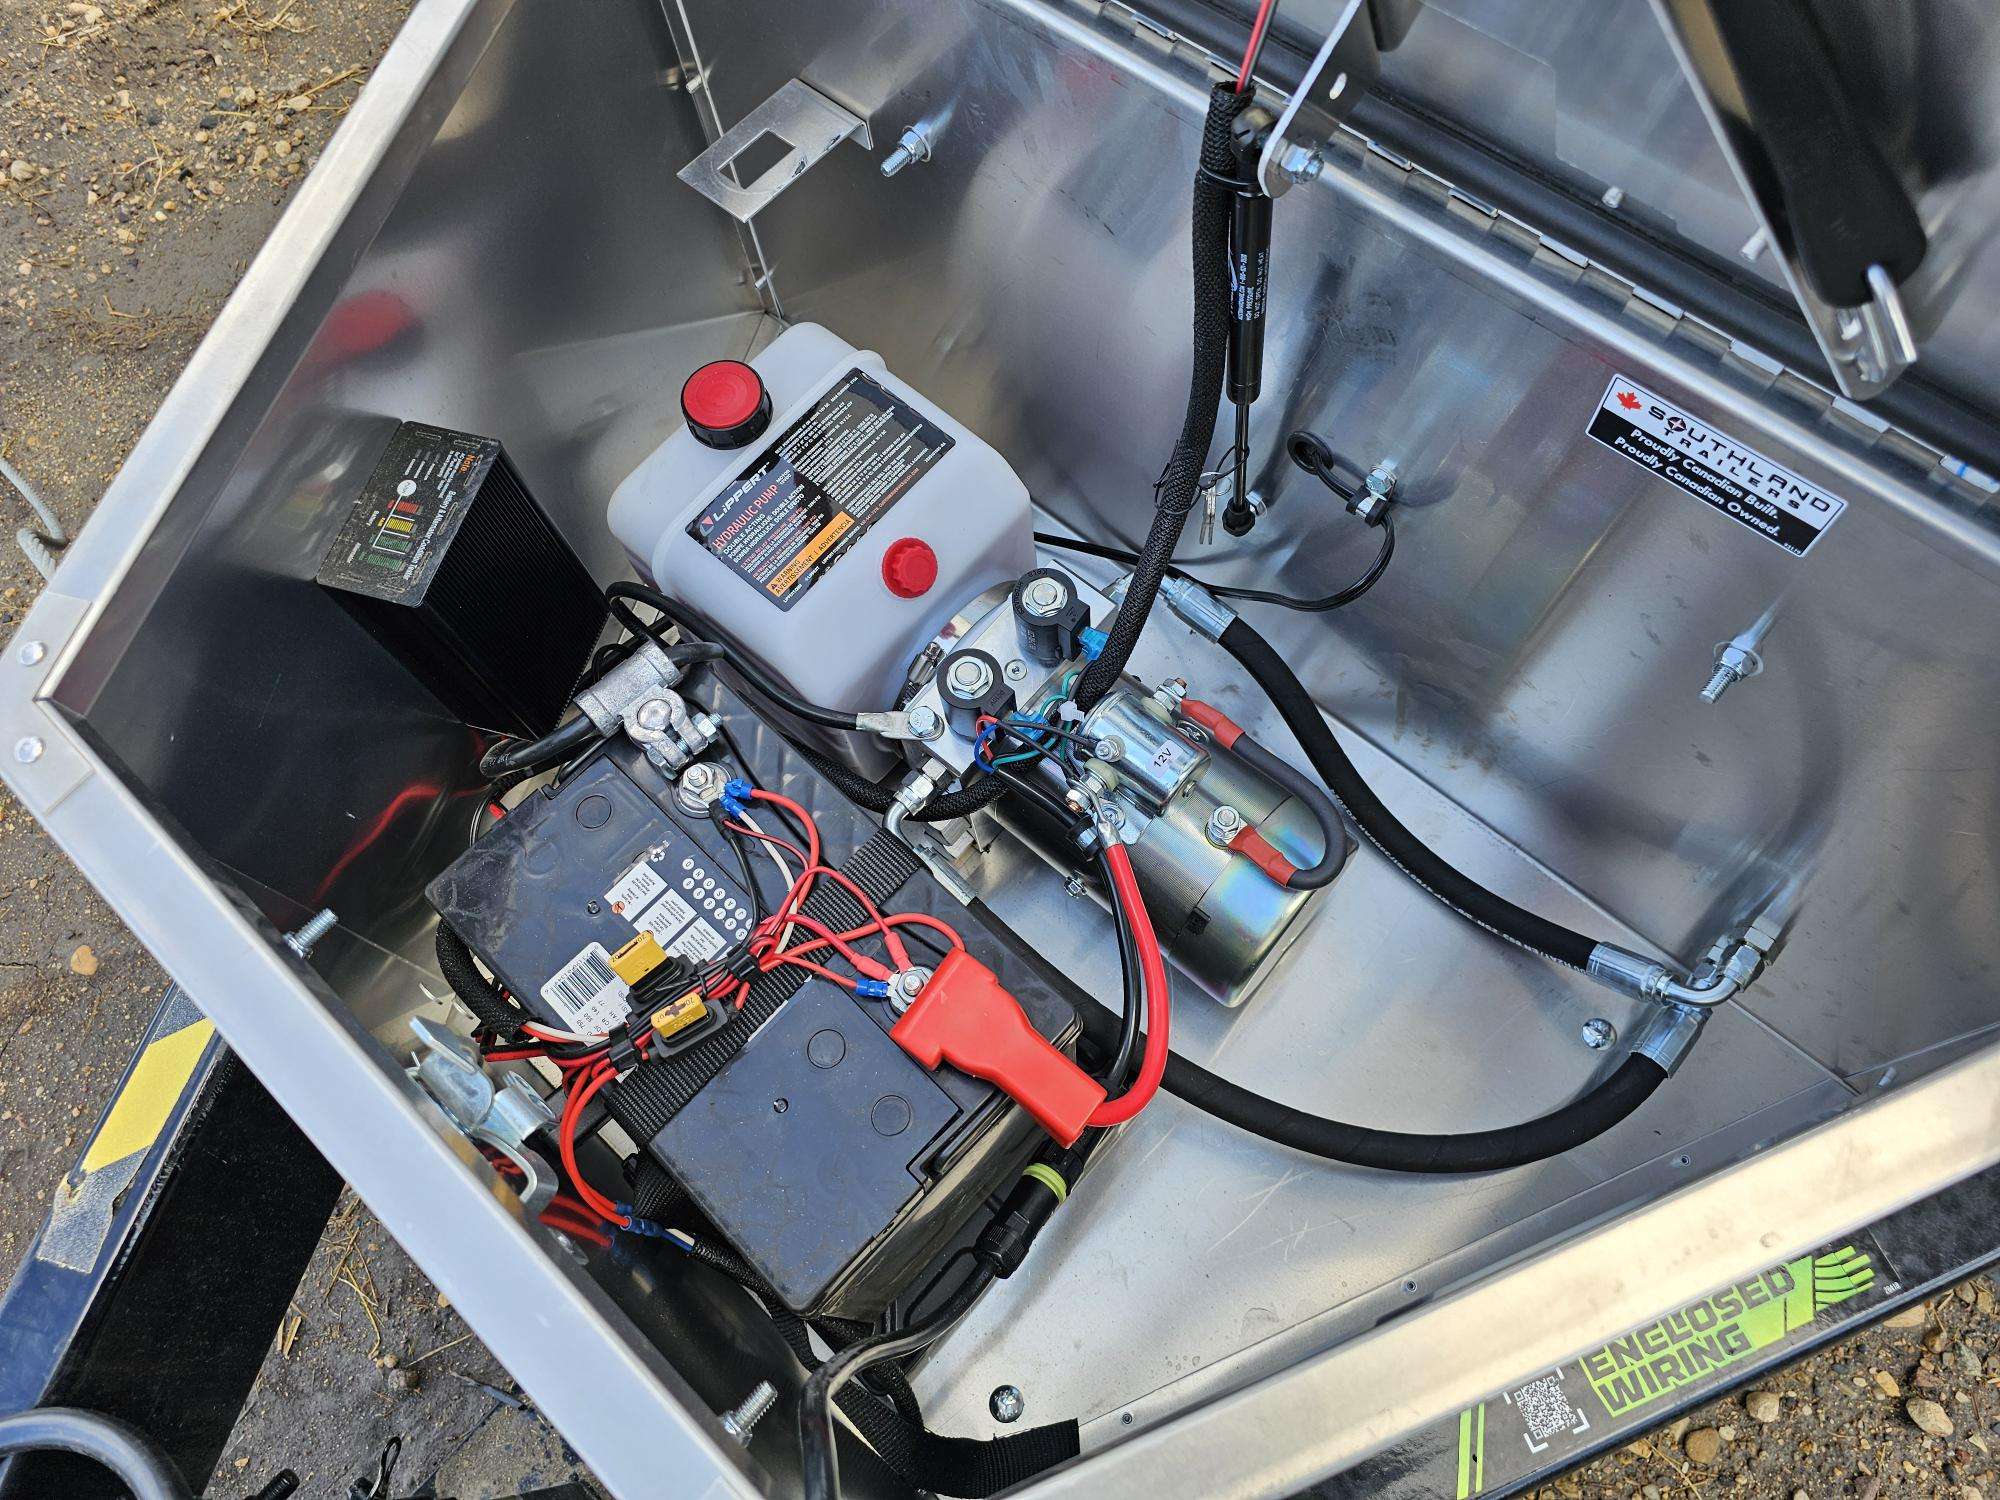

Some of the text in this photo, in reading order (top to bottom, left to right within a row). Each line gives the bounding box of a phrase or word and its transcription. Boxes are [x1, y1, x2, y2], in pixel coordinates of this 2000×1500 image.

[458, 453, 475, 474] Note:
[1614, 437, 1779, 536] Proudly Canadian Owned.
[1630, 429, 1779, 519] Proudly Canadian Built.
[1648, 405, 1831, 513] SOUTHLAND
[1664, 428, 1800, 509] TRAILERS
[423, 513, 443, 539] Alternator
[439, 489, 456, 510] Battery
[712, 504, 759, 550] HYDRAULIC
[754, 483, 780, 509] PUMP
[723, 512, 766, 554] DOUBLE ACTING
[727, 541, 744, 558] POMPE
[771, 498, 790, 516] DOUBLE
[787, 483, 804, 500] ACTION
[788, 493, 805, 509] EFECTO
[775, 554, 814, 594] AVERTISSEMENT
[818, 518, 851, 551] ADVERTENCIA
[776, 558, 800, 583] WARNING
[1152, 747, 1173, 768] 12V
[1583, 1265, 1795, 1381] ENCLOSED
[1597, 1323, 1752, 1412] WIRING
